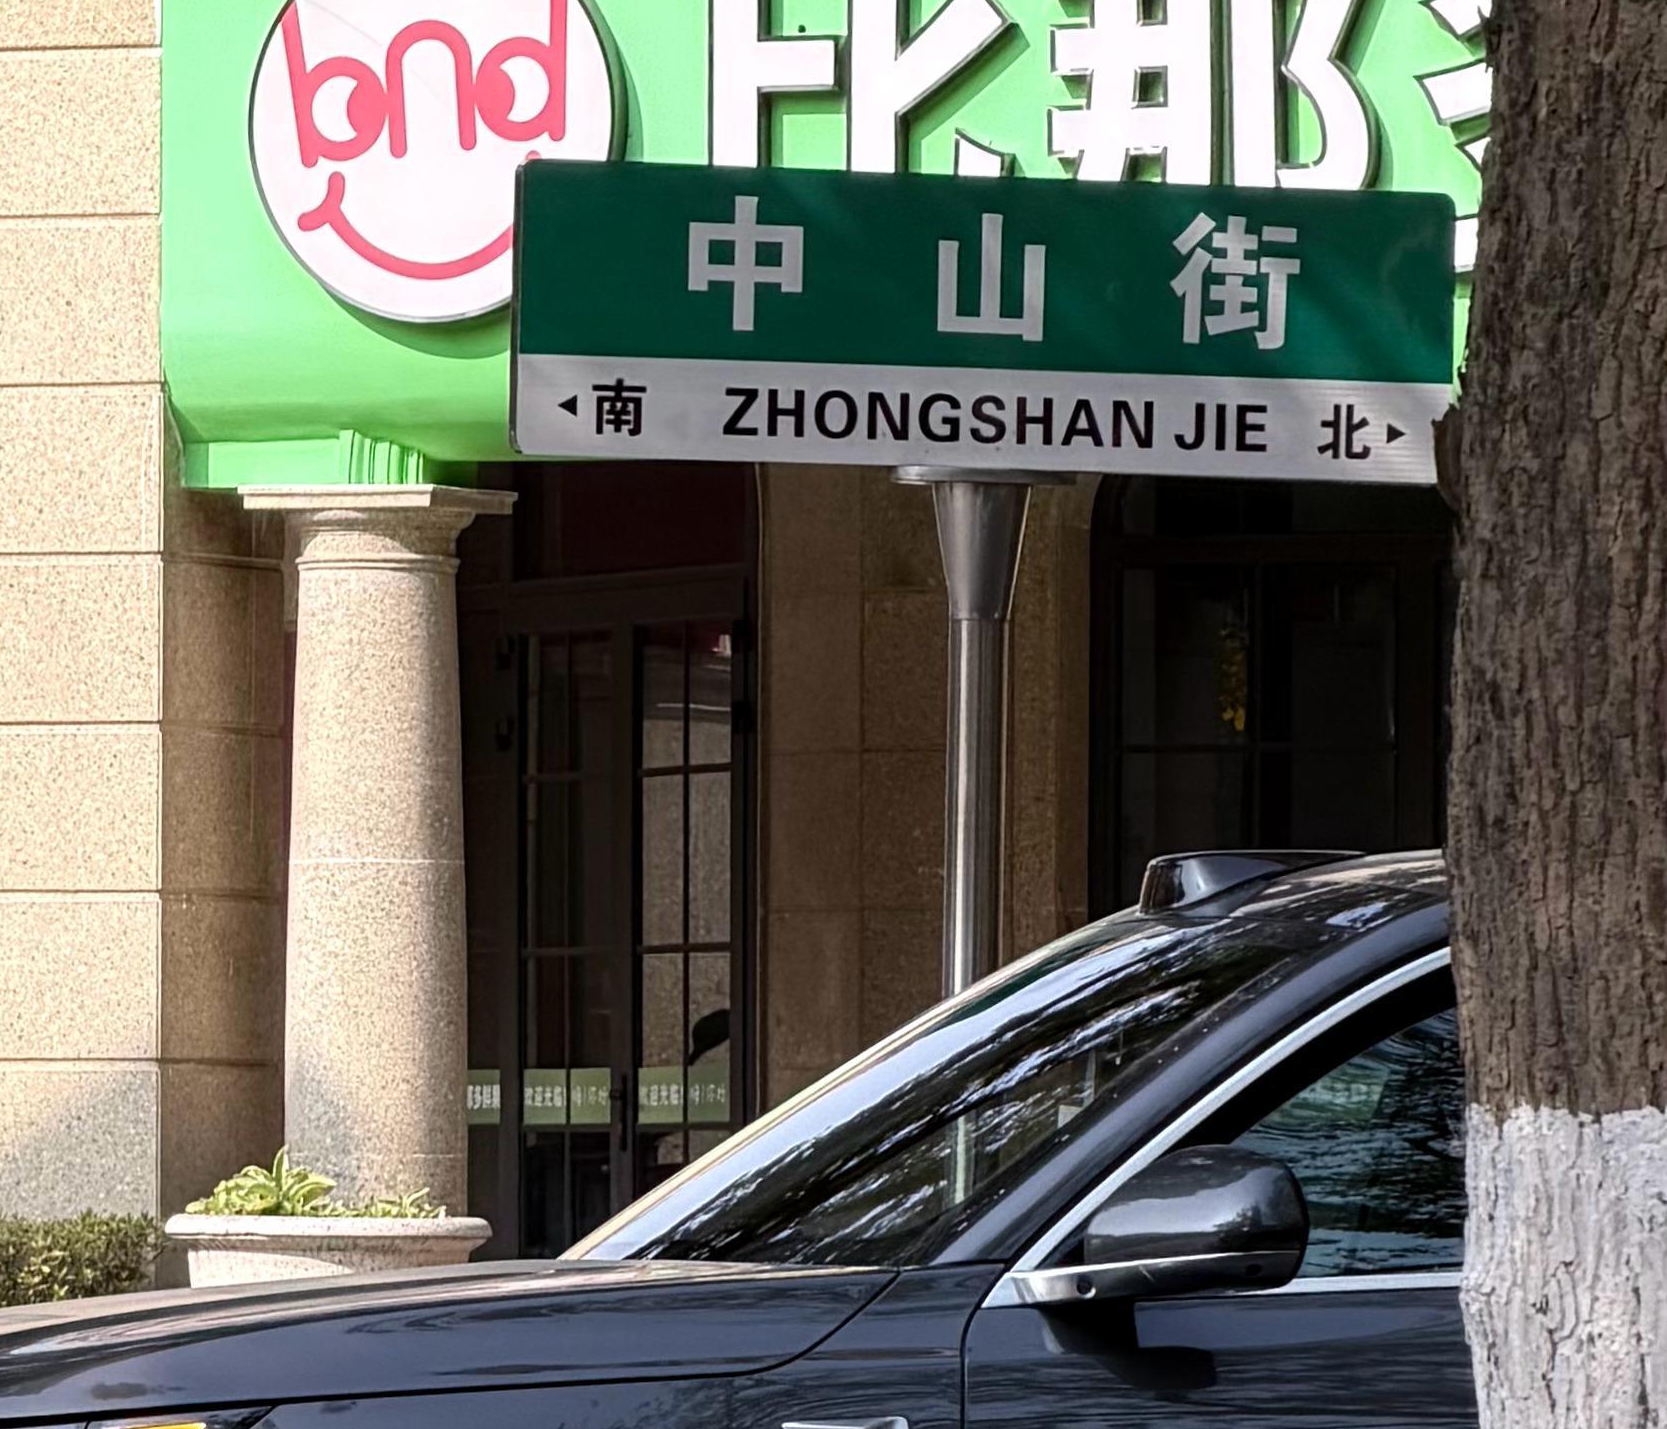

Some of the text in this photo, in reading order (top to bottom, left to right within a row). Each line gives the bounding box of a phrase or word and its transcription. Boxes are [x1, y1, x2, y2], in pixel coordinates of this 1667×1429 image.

[687, 194, 1301, 350] 中山街
[591, 378, 647, 437] 南
[722, 386, 1268, 453] ZHONGSHAN JIE
[1317, 403, 1372, 460] 北
